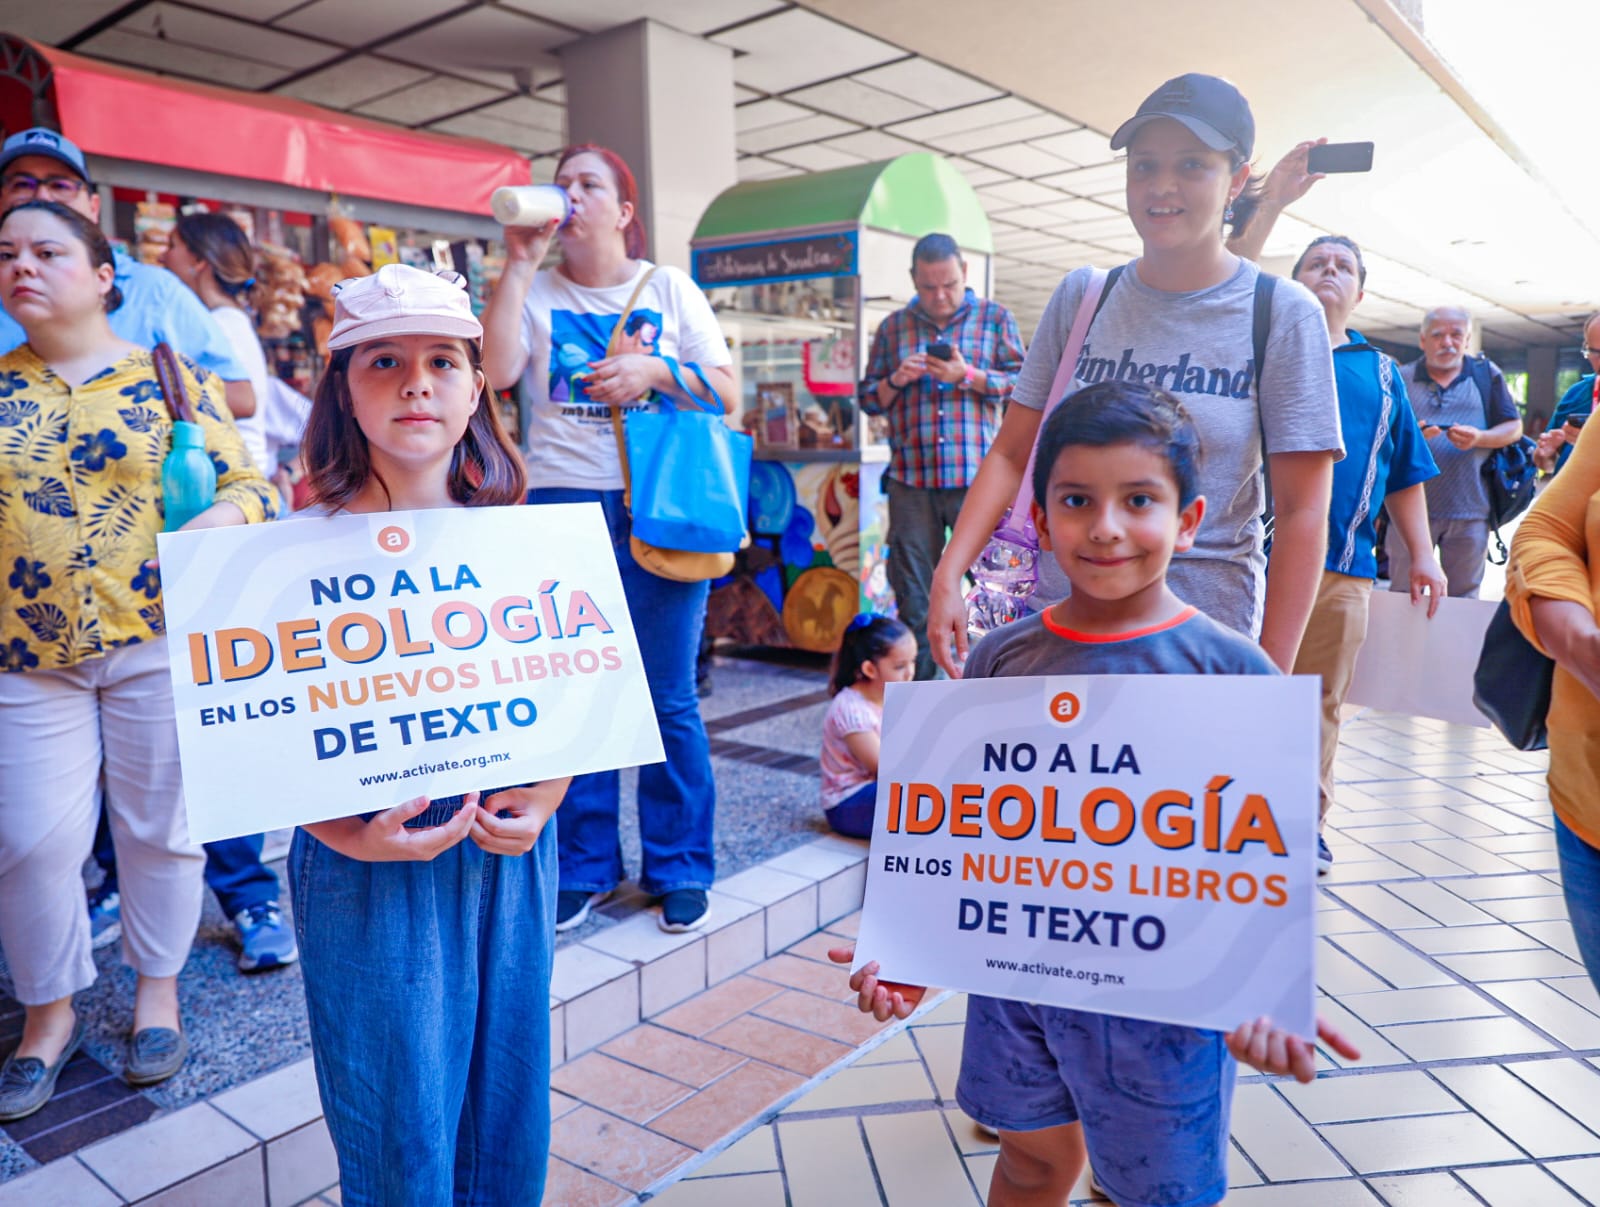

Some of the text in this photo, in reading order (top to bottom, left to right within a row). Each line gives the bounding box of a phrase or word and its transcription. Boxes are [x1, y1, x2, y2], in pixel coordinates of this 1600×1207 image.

[310, 564, 482, 605] NO A LA
[187, 579, 614, 686] IDEOLOGÍA
[200, 646, 623, 726] EN LOS NUEVOS LIBROS
[313, 697, 537, 760] DE TEXTO
[359, 752, 511, 786] www.activate.org.mx
[983, 743, 1141, 775] NO A LA
[887, 775, 1288, 857] IDEOLOGÍA
[884, 853, 1288, 907] EN LOS NUEVOS LIBROS
[958, 898, 1166, 951] DE TEXTO
[986, 958, 1125, 985] www.activate.org.mx
